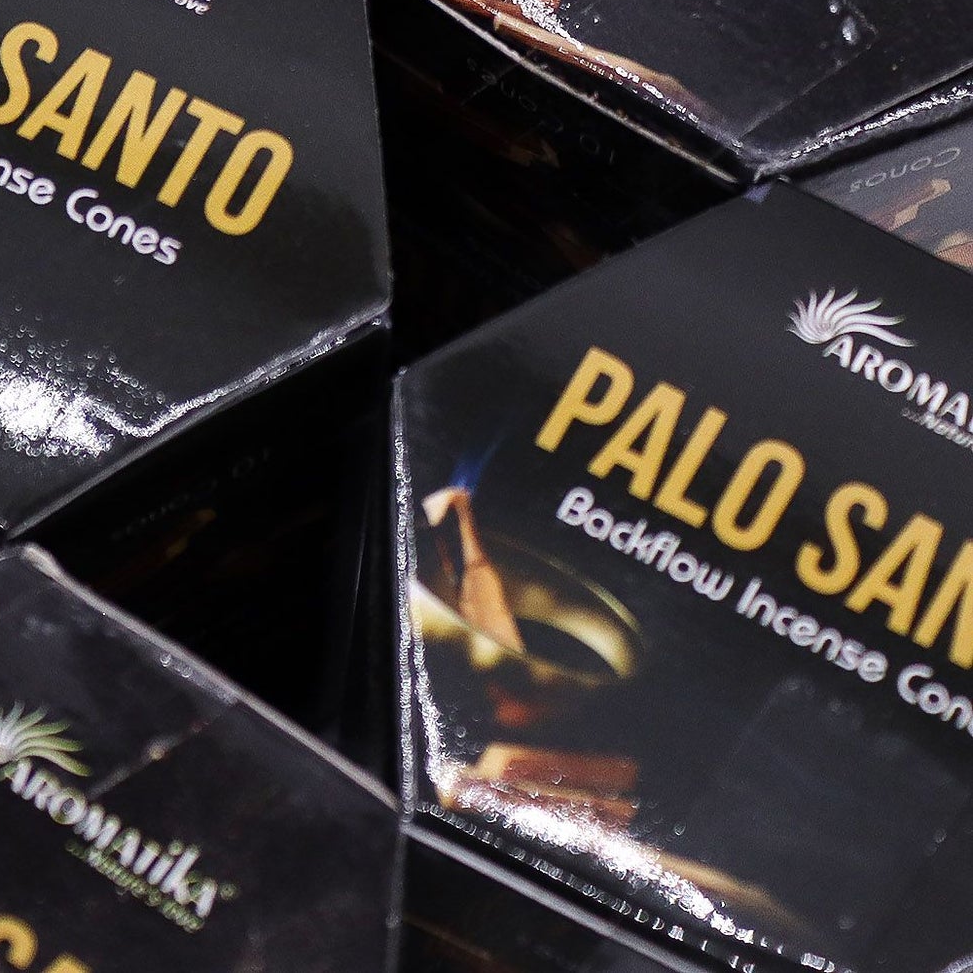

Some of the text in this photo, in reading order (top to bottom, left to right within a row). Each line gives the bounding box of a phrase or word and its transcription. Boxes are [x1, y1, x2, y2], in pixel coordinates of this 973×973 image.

[65, 187, 182, 266] Cones
[535, 346, 806, 551] PALO
[823, 334, 973, 433] AROMA
[556, 486, 973, 738] Backflow Incense Con
